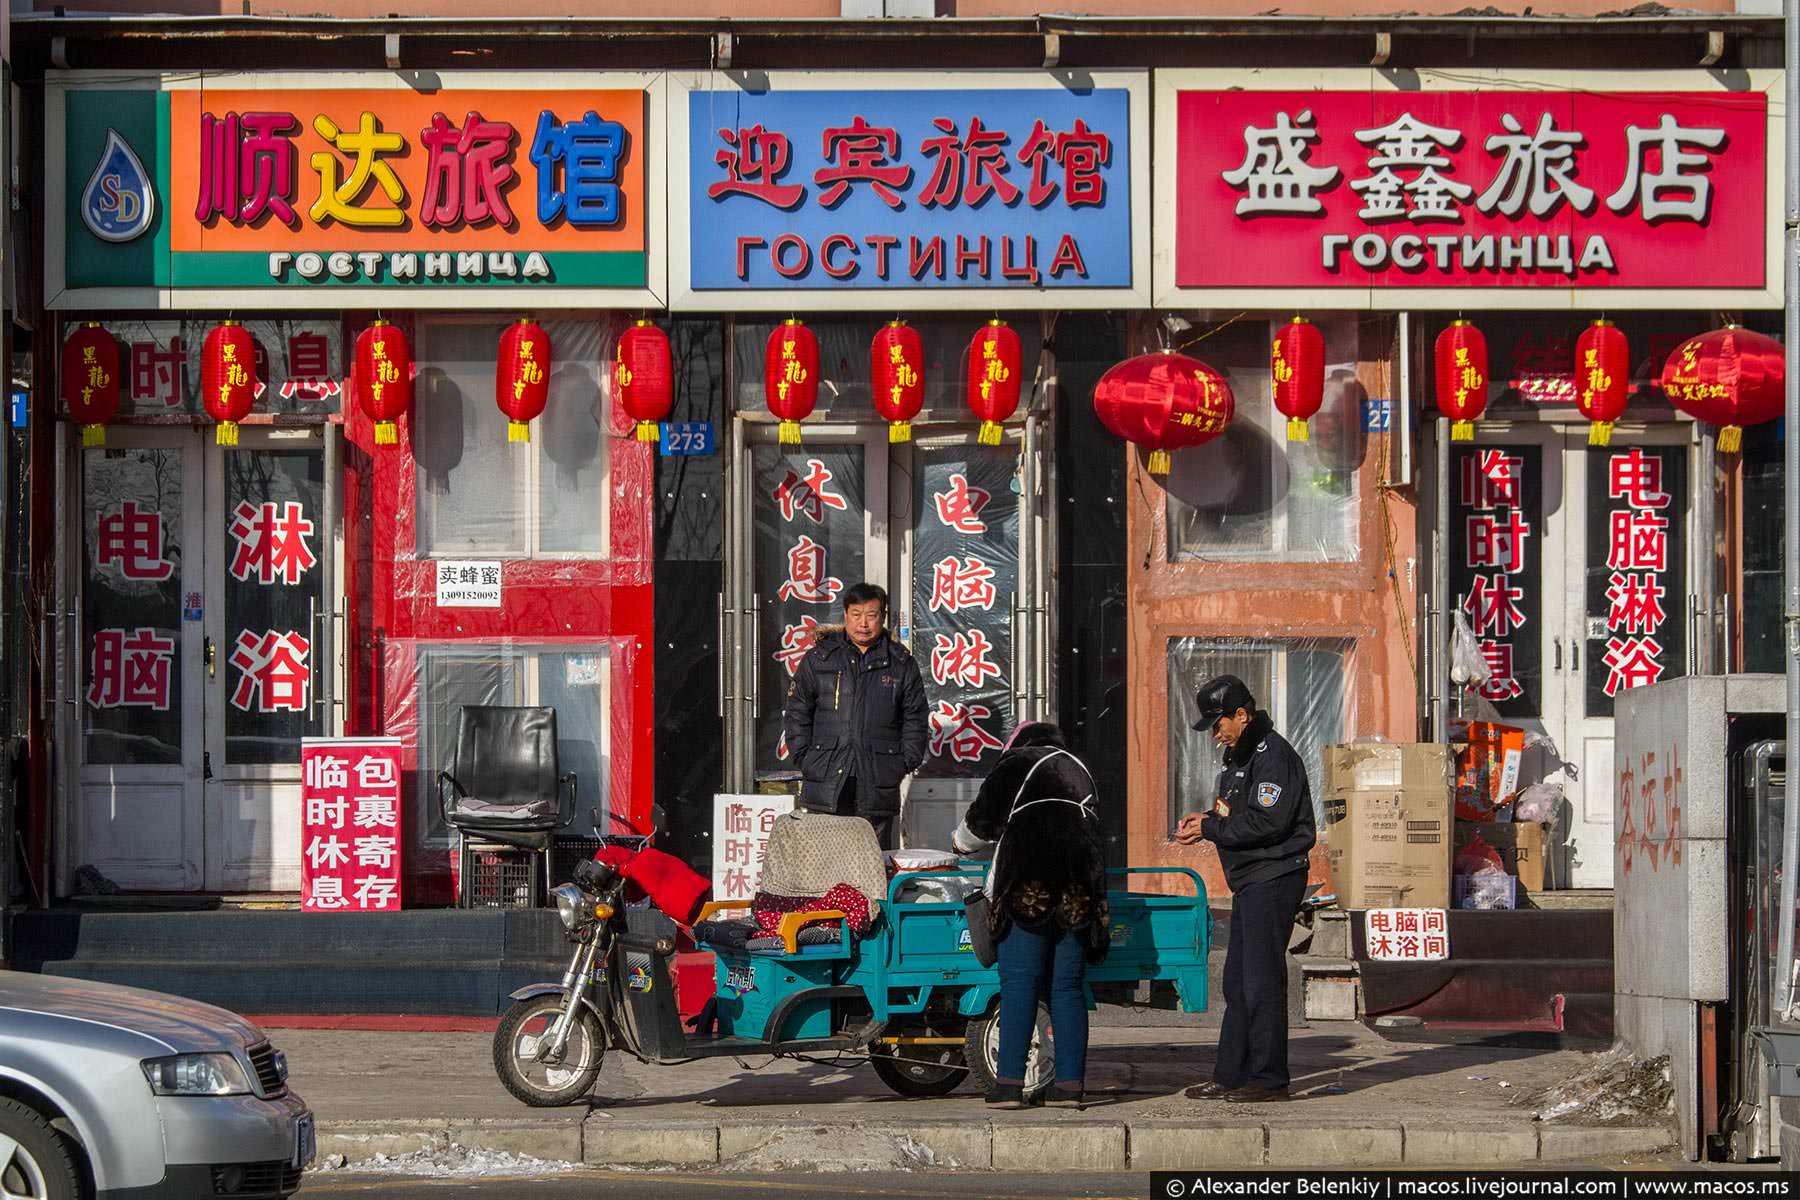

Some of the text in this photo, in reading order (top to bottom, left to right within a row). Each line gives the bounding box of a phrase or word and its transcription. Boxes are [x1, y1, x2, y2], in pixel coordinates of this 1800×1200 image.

[194, 109, 626, 228] 顺达旅馆
[708, 116, 1109, 208] 迎宾旅馆
[1221, 110, 1727, 222] 盛鑫旅店
[268, 252, 551, 279] ГОСТИНИЦА
[735, 233, 1087, 284] ГОСТИНЦА
[1321, 233, 1616, 274] ГОСТИНЦА
[668, 432, 705, 450] 273
[1368, 409, 1391, 428] 27
[87, 500, 174, 711] 电脑
[229, 500, 316, 712] 淋浴
[440, 565, 499, 585] 卖蜂蜜
[441, 591, 498, 600] 13091520092
[929, 473, 1004, 763] 电脑淋浴
[1461, 448, 1530, 702] 临时休息
[1602, 447, 1672, 698] 电脑淋浴
[305, 755, 350, 908] 临时休息
[352, 755, 398, 908] 包裹寄存
[1370, 911, 1444, 934] 电脑间
[1370, 936, 1446, 958] 沐浴间
